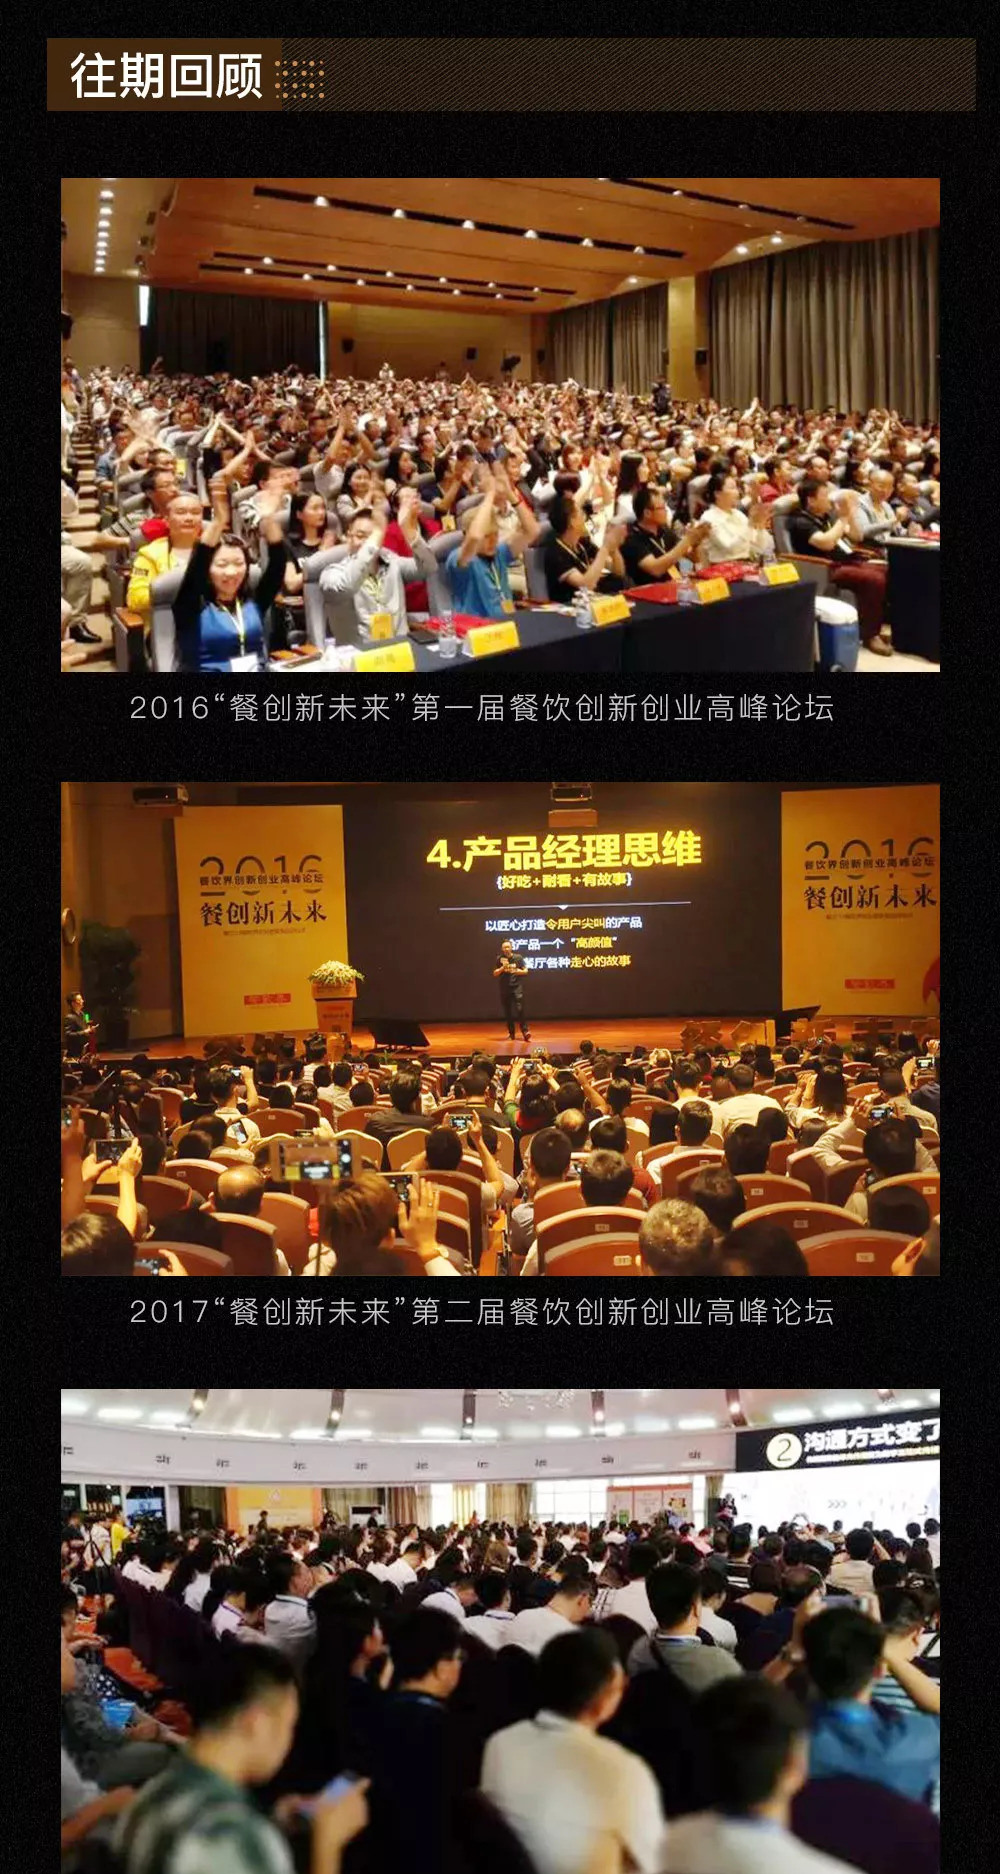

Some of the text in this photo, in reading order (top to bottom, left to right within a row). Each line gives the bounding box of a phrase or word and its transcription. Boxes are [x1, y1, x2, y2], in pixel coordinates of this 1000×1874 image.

[426, 830, 702, 872] 4.产品经理思维
[804, 883, 937, 910] 餐创新未来
[200, 899, 327, 927] 餐创新未来
[485, 916, 643, 932] 以匠心打造令用户尖叫的产品
